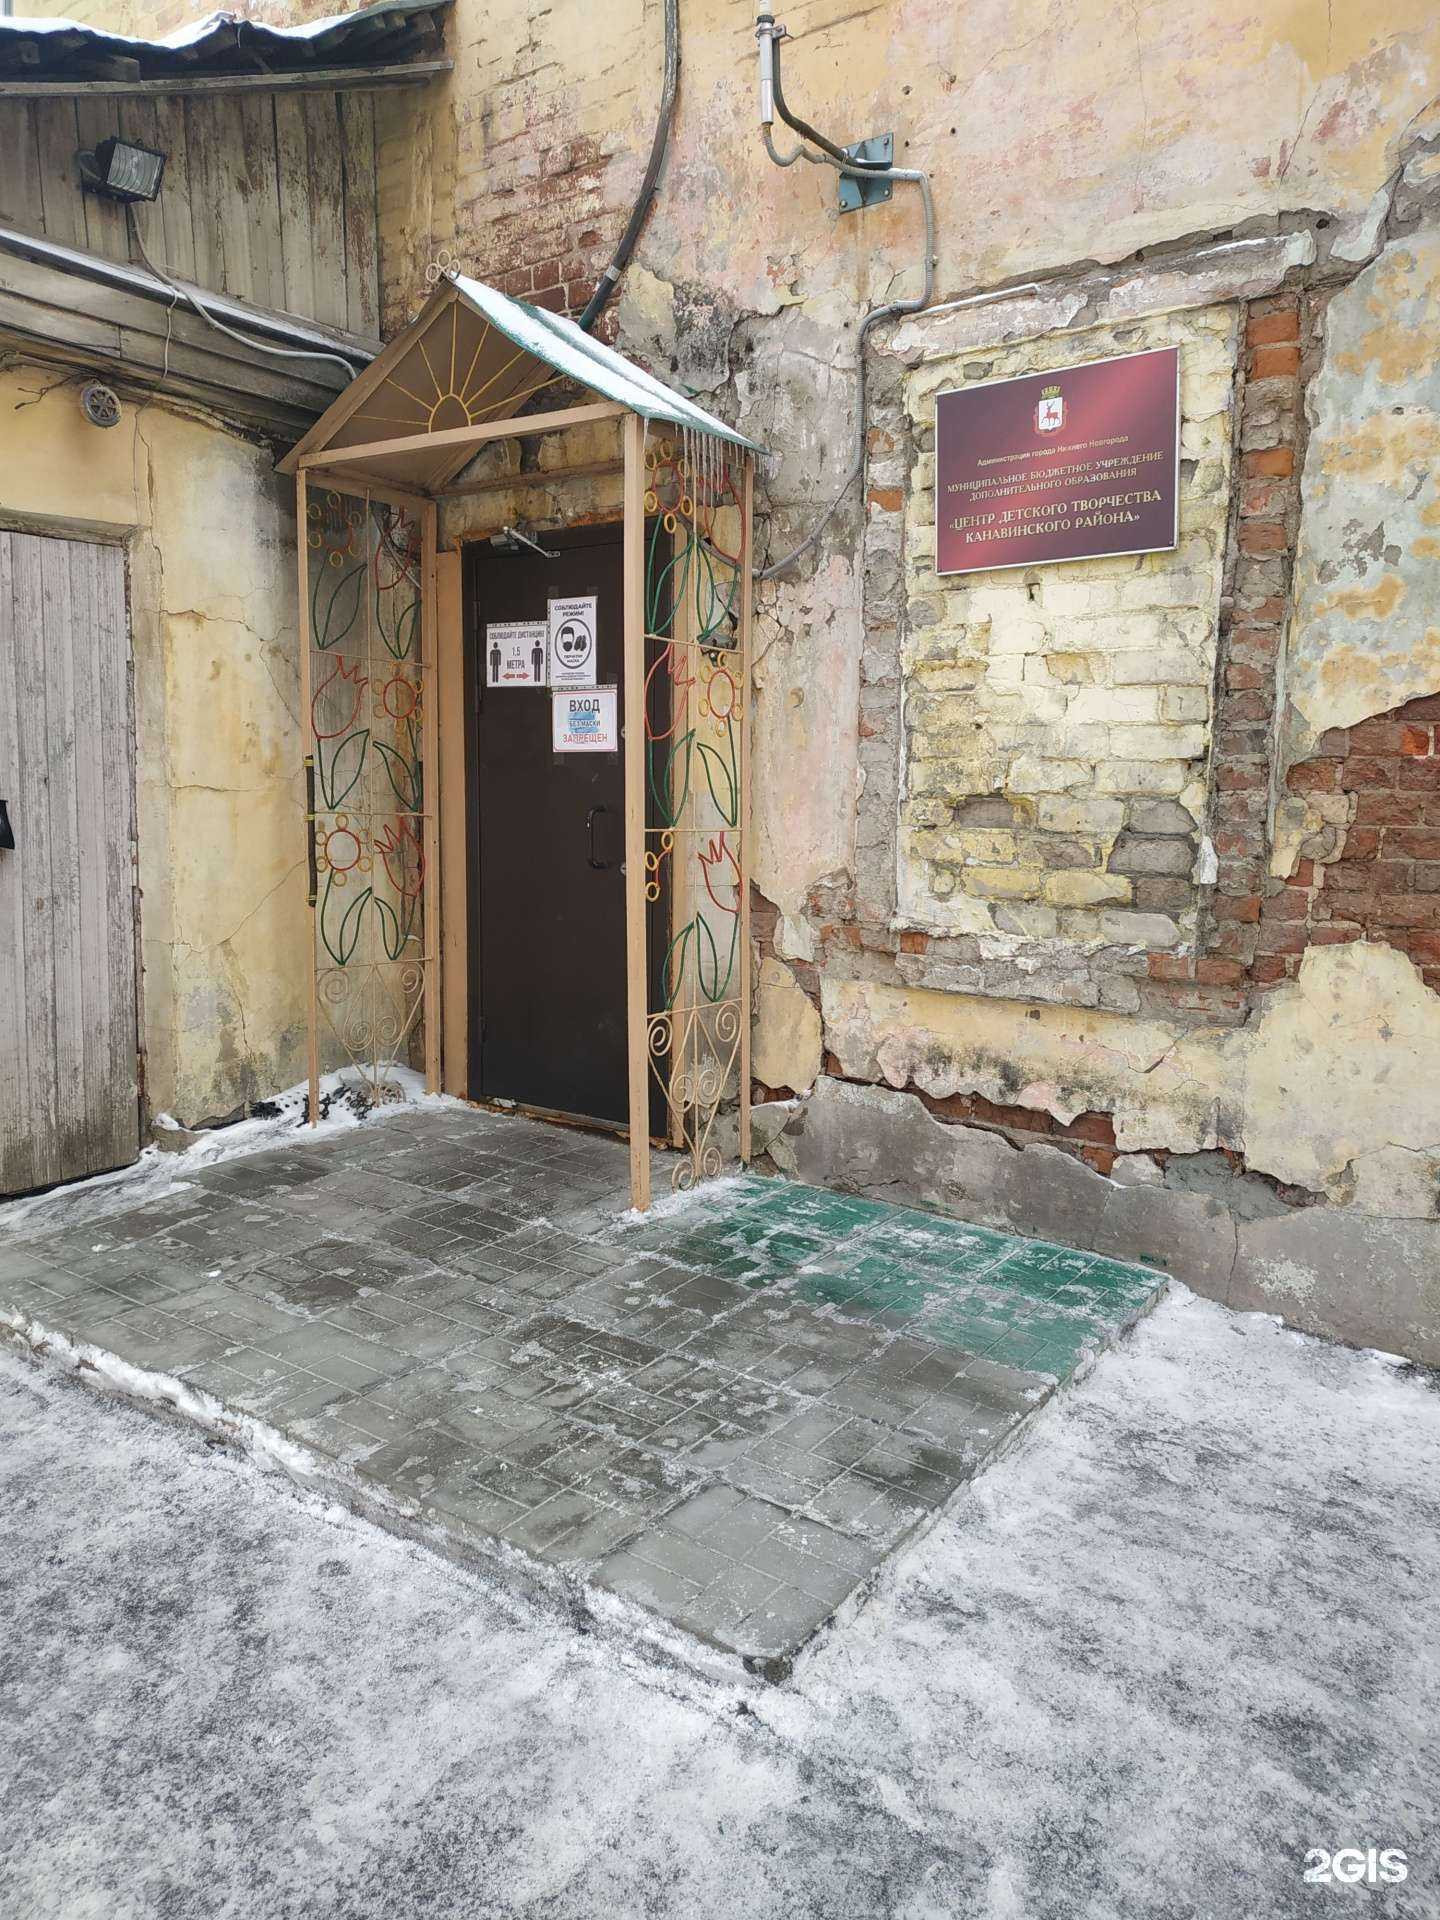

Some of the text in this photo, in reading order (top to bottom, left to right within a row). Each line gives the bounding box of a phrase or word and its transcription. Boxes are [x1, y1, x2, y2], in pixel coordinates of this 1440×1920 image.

[977, 435, 1129, 467] Администрация города Нижнего Новгорода
[947, 451, 1164, 493] МУНИЦИПАЛЬНОЕ БЮДЖЕТНОЕ УЧРЕЖДЕНИЕ
[969, 468, 1137, 502] ДОПОЛНИТЕЛЬНОГО ОБРАЗОВАНИЯ
[949, 490, 1162, 531] «ЦЕНТР ДЕТСКОГО ТВОРЧЕСТВА
[965, 511, 1140, 543] КАНАВИНСКОГО РАЙОНА»
[554, 602, 592, 611] СОБЛЮДАЙТЕ
[489, 631, 517, 640] СОБЛЮДАЙТЕ
[506, 659, 526, 670] МЕТРА
[569, 699, 600, 713] ВХОД
[581, 719, 601, 727] МАСКИ
[562, 733, 608, 744] ЗАПРЕЩЕН
